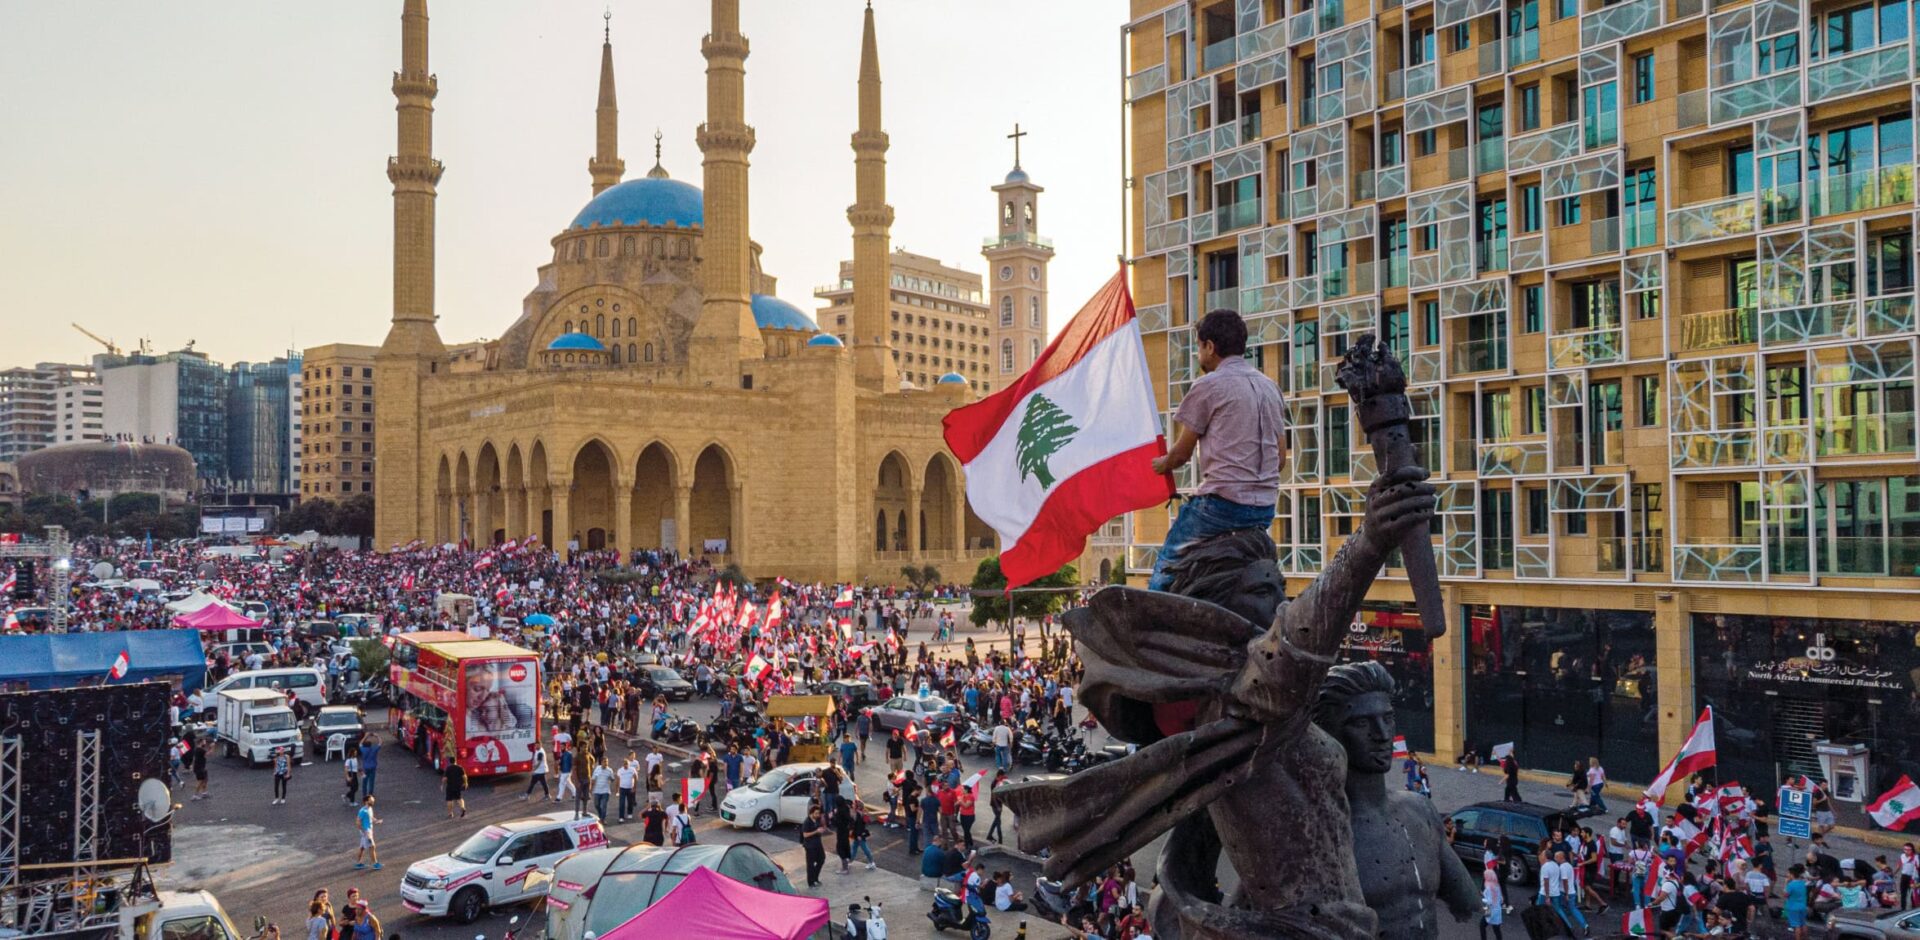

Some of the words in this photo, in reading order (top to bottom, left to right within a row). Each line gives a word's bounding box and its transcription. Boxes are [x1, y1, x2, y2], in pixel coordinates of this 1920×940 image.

[1840, 665, 1868, 675] شمال
[1865, 666, 1893, 680] مصرف
[1748, 671, 1772, 680] North
[1774, 673, 1800, 682] Africa
[1802, 675, 1855, 686] Commercial
[1856, 680, 1880, 688] Bank
[1792, 792, 1800, 801] P
